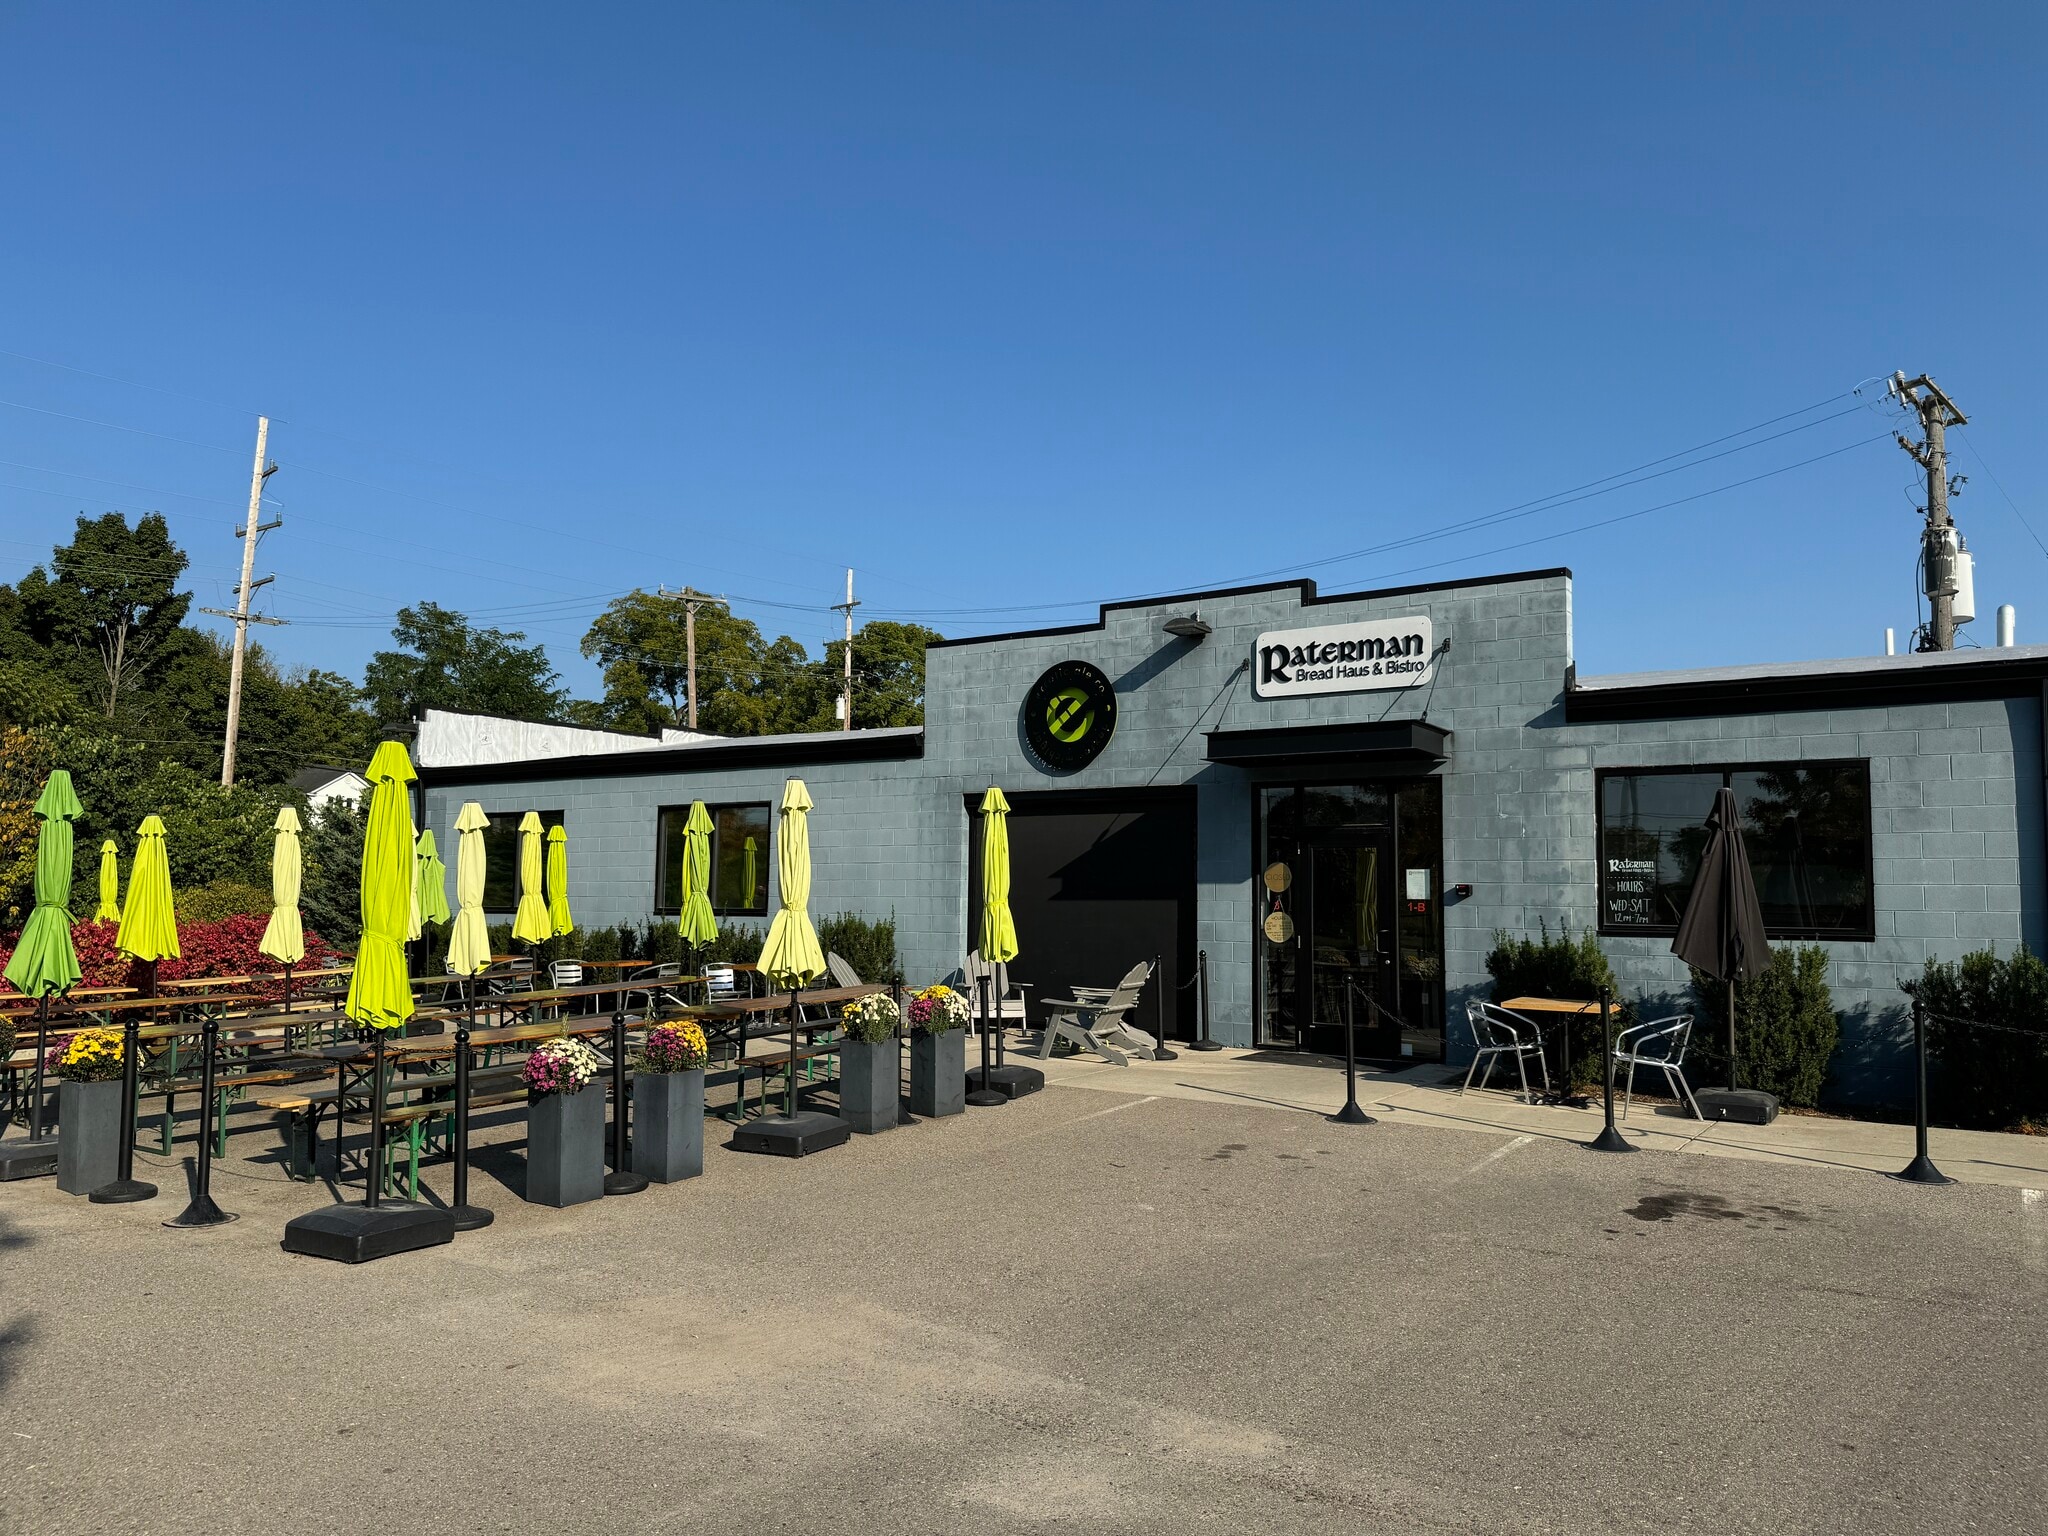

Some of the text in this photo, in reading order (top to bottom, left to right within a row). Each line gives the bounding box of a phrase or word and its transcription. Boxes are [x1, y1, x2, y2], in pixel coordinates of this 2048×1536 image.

[1259, 634, 1424, 685] Raterman
[1296, 660, 1425, 682] Bread Haus & Bistro
[1608, 858, 1655, 872] Raterman
[1616, 880, 1645, 893] HOURS
[1407, 902, 1426, 912] 1-B
